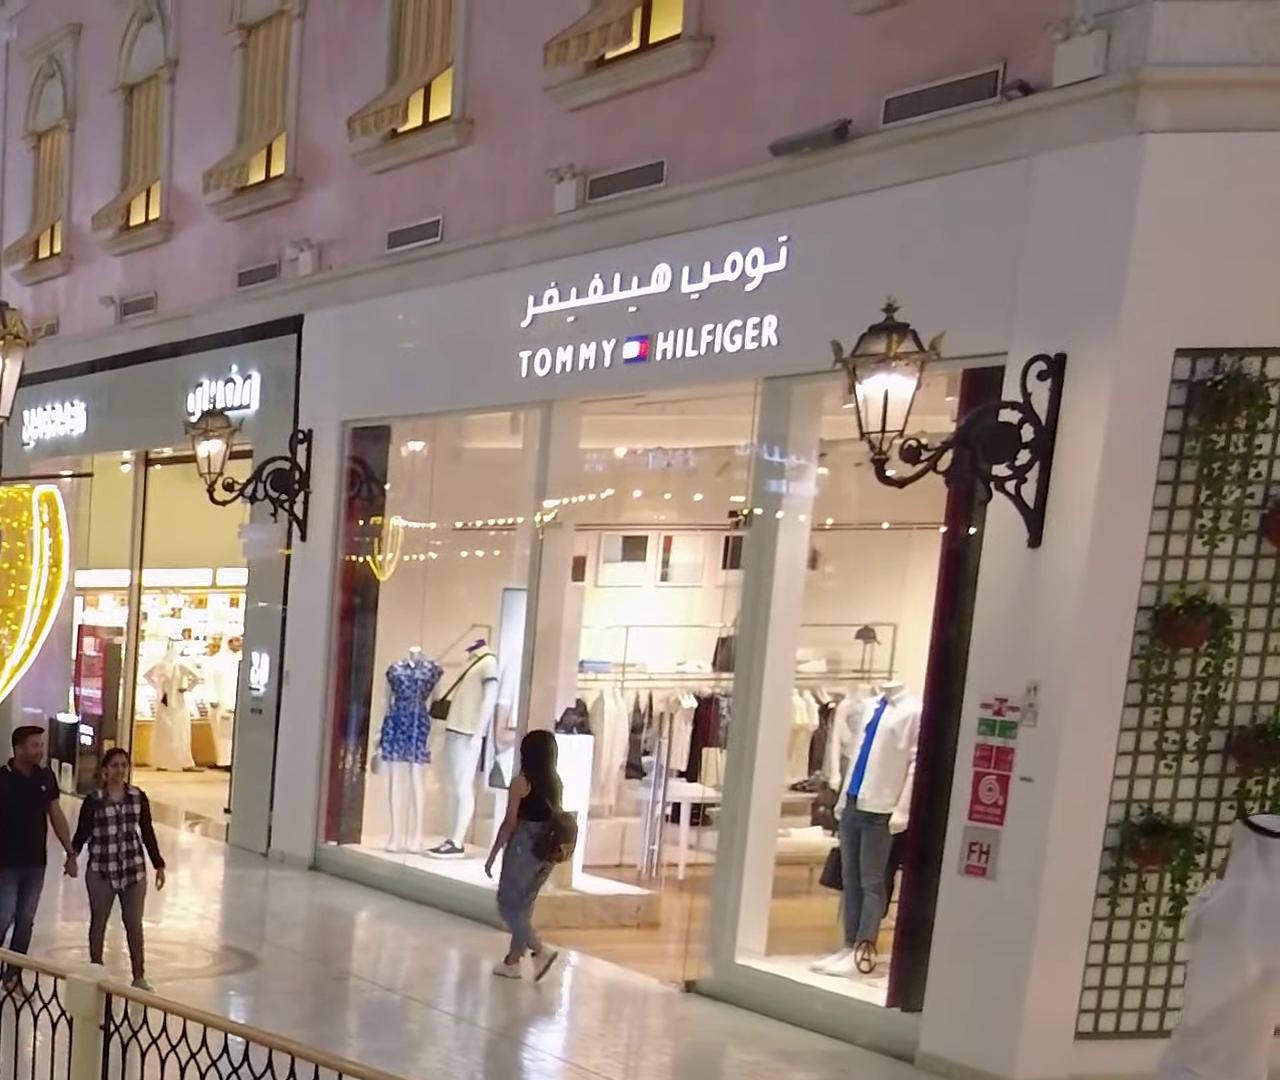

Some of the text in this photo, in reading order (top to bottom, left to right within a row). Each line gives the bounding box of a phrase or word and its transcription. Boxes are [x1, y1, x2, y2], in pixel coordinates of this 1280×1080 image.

[680, 235, 789, 299] تومي
[518, 313, 779, 378] TOMMY HILFIGER
[967, 842, 991, 864] FH
